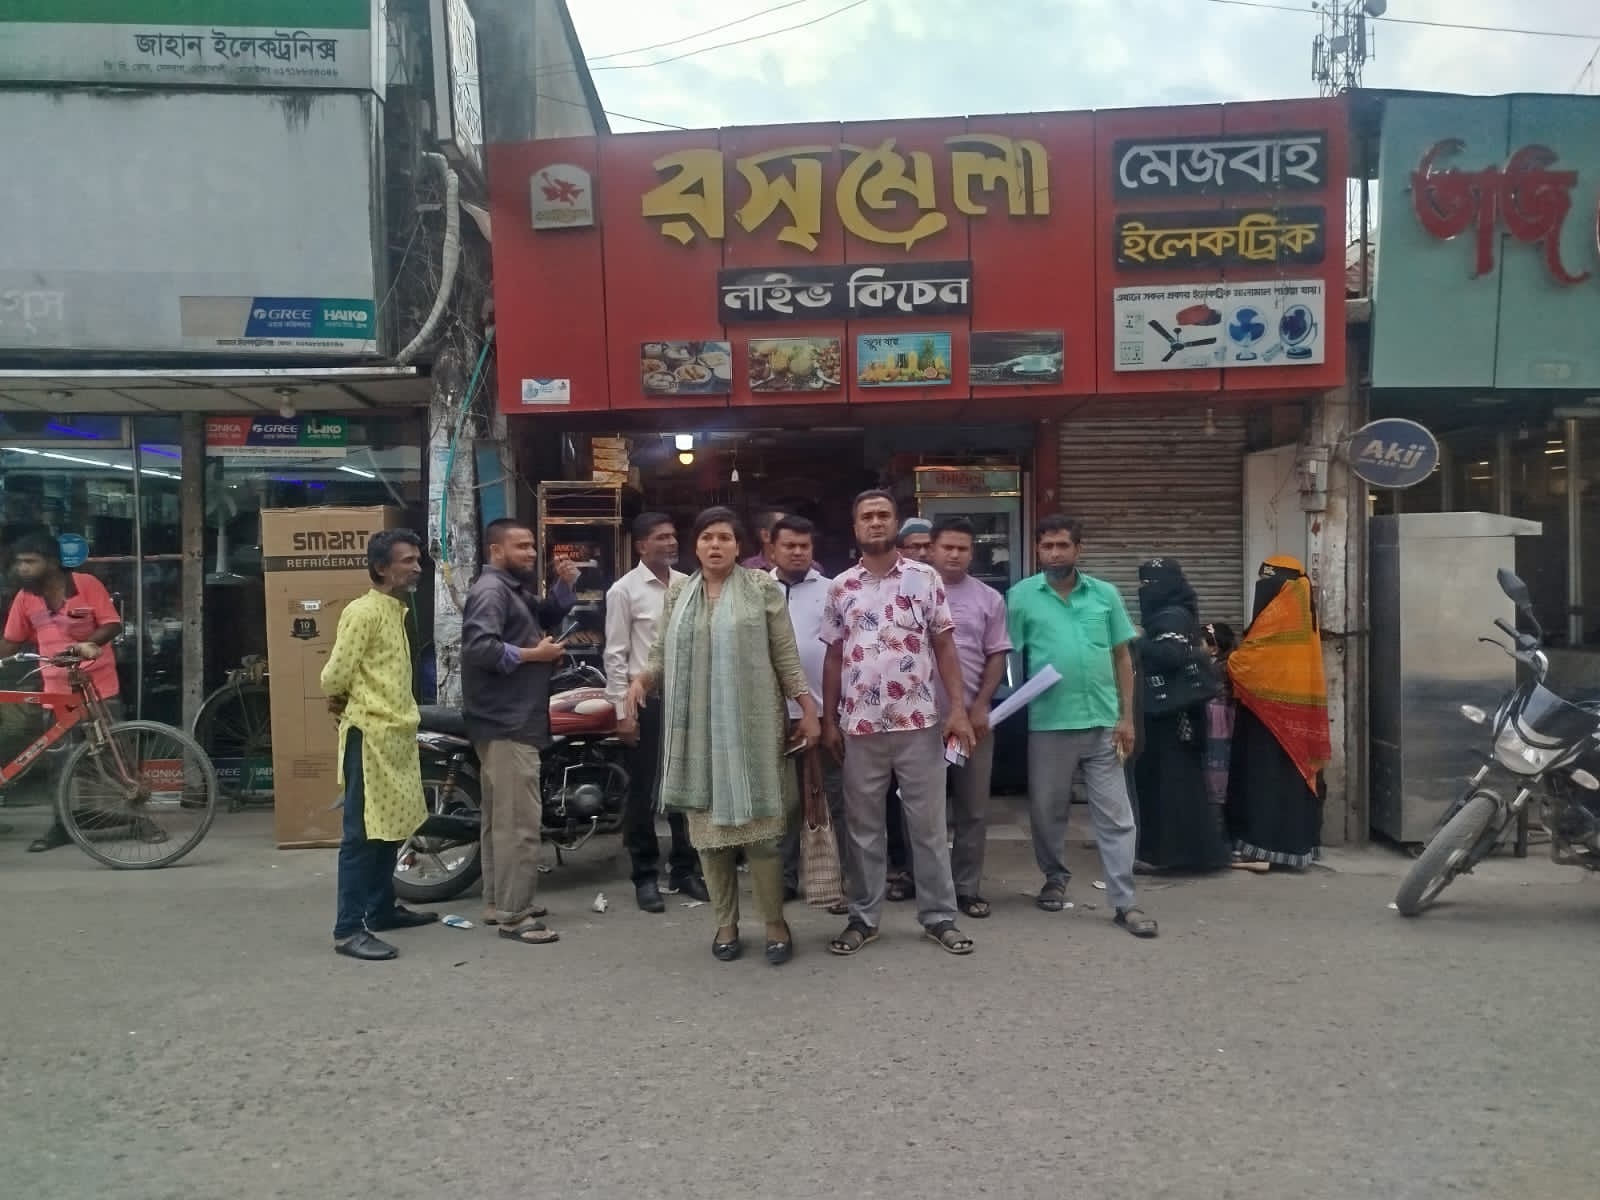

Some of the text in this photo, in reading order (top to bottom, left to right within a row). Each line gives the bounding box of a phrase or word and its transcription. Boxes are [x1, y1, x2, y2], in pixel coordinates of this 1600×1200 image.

[134, 29, 339, 62] জাহান ইলেকট্রনিক্স
[1119, 137, 1321, 188] মেজবাহ
[1119, 213, 1320, 263] ইলেকট্রিক
[721, 268, 970, 314] লাইভ কিচেন
[268, 309, 313, 321] GREE
[323, 309, 368, 322] HAIKO
[206, 423, 241, 433] ONKA
[1360, 439, 1427, 469] Akij
[286, 557, 369, 569] REFRIGERATO
